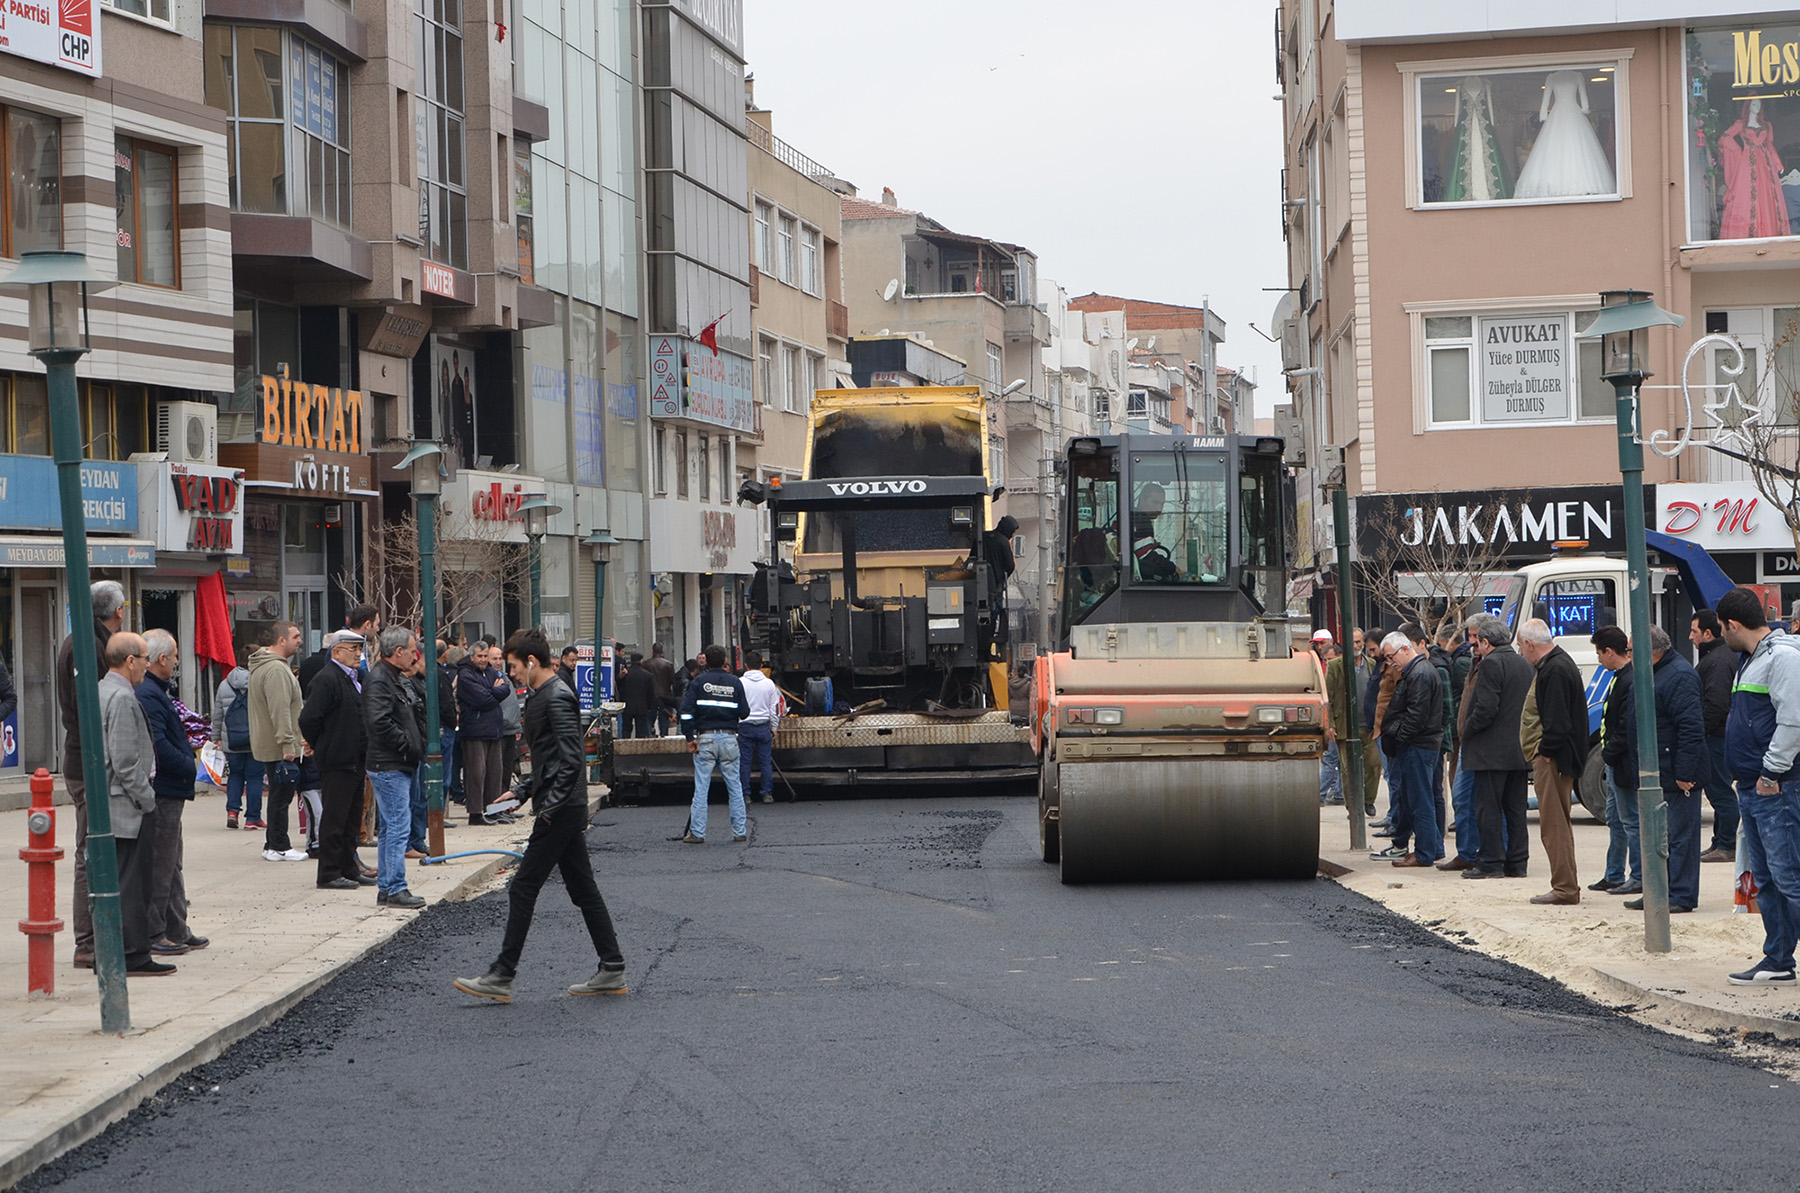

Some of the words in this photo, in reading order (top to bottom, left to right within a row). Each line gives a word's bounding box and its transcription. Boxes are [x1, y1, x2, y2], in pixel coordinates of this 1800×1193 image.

[9, 0, 50, 26] PARTİSİ
[61, 32, 90, 61] CHP
[426, 264, 455, 297] NOTER
[1487, 323, 1561, 344] AVUKAT
[1488, 350, 1513, 366] Yüce
[1515, 348, 1561, 367] DURMUŞ
[1519, 366, 1528, 376] &
[1488, 379, 1523, 397] Züheyla
[1525, 376, 1562, 394] DÜLGER
[261, 363, 363, 454] BİRTAT
[1506, 397, 1545, 415] DURMUŞ
[1193, 437, 1225, 448] HAMM
[81, 468, 119, 489] EYDAN
[294, 453, 350, 493] KÖFTE
[826, 479, 928, 496] VOLVO
[82, 496, 126, 525] REKÇİSİ
[186, 517, 234, 550] AVM
[1399, 500, 1613, 547] JAKAMEN
[7, 547, 46, 562] MEYDAN
[578, 647, 611, 657] BİRAT
